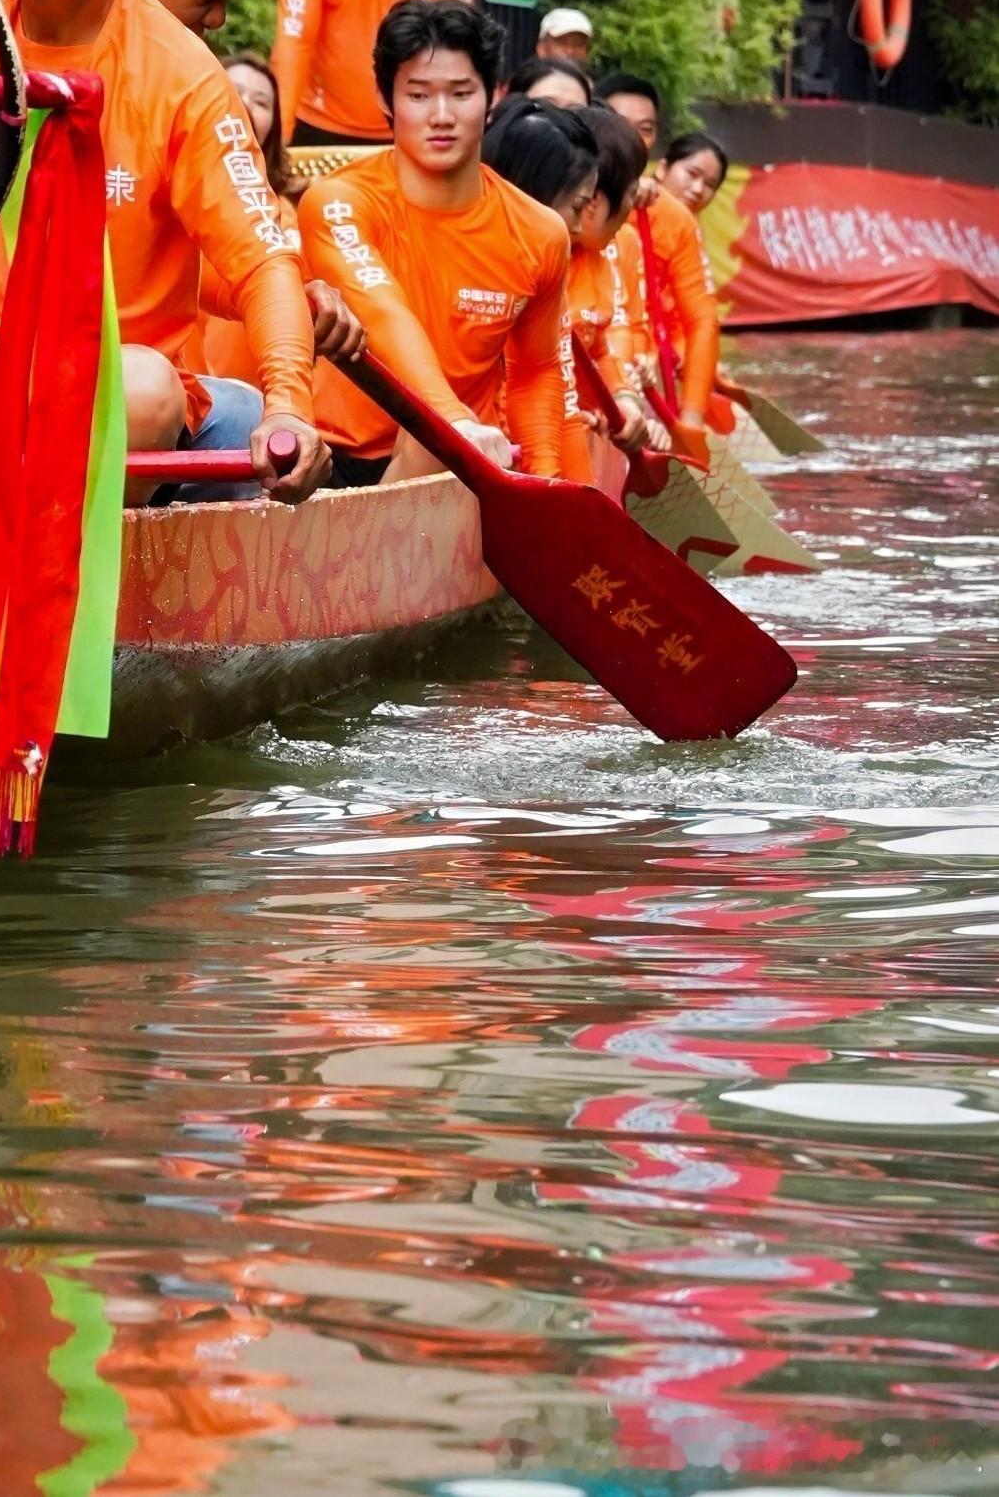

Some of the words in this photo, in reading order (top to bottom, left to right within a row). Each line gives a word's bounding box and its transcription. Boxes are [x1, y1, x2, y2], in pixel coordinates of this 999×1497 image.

[323, 199, 391, 290] 中国平安
[458, 288, 507, 304] 中国平安
